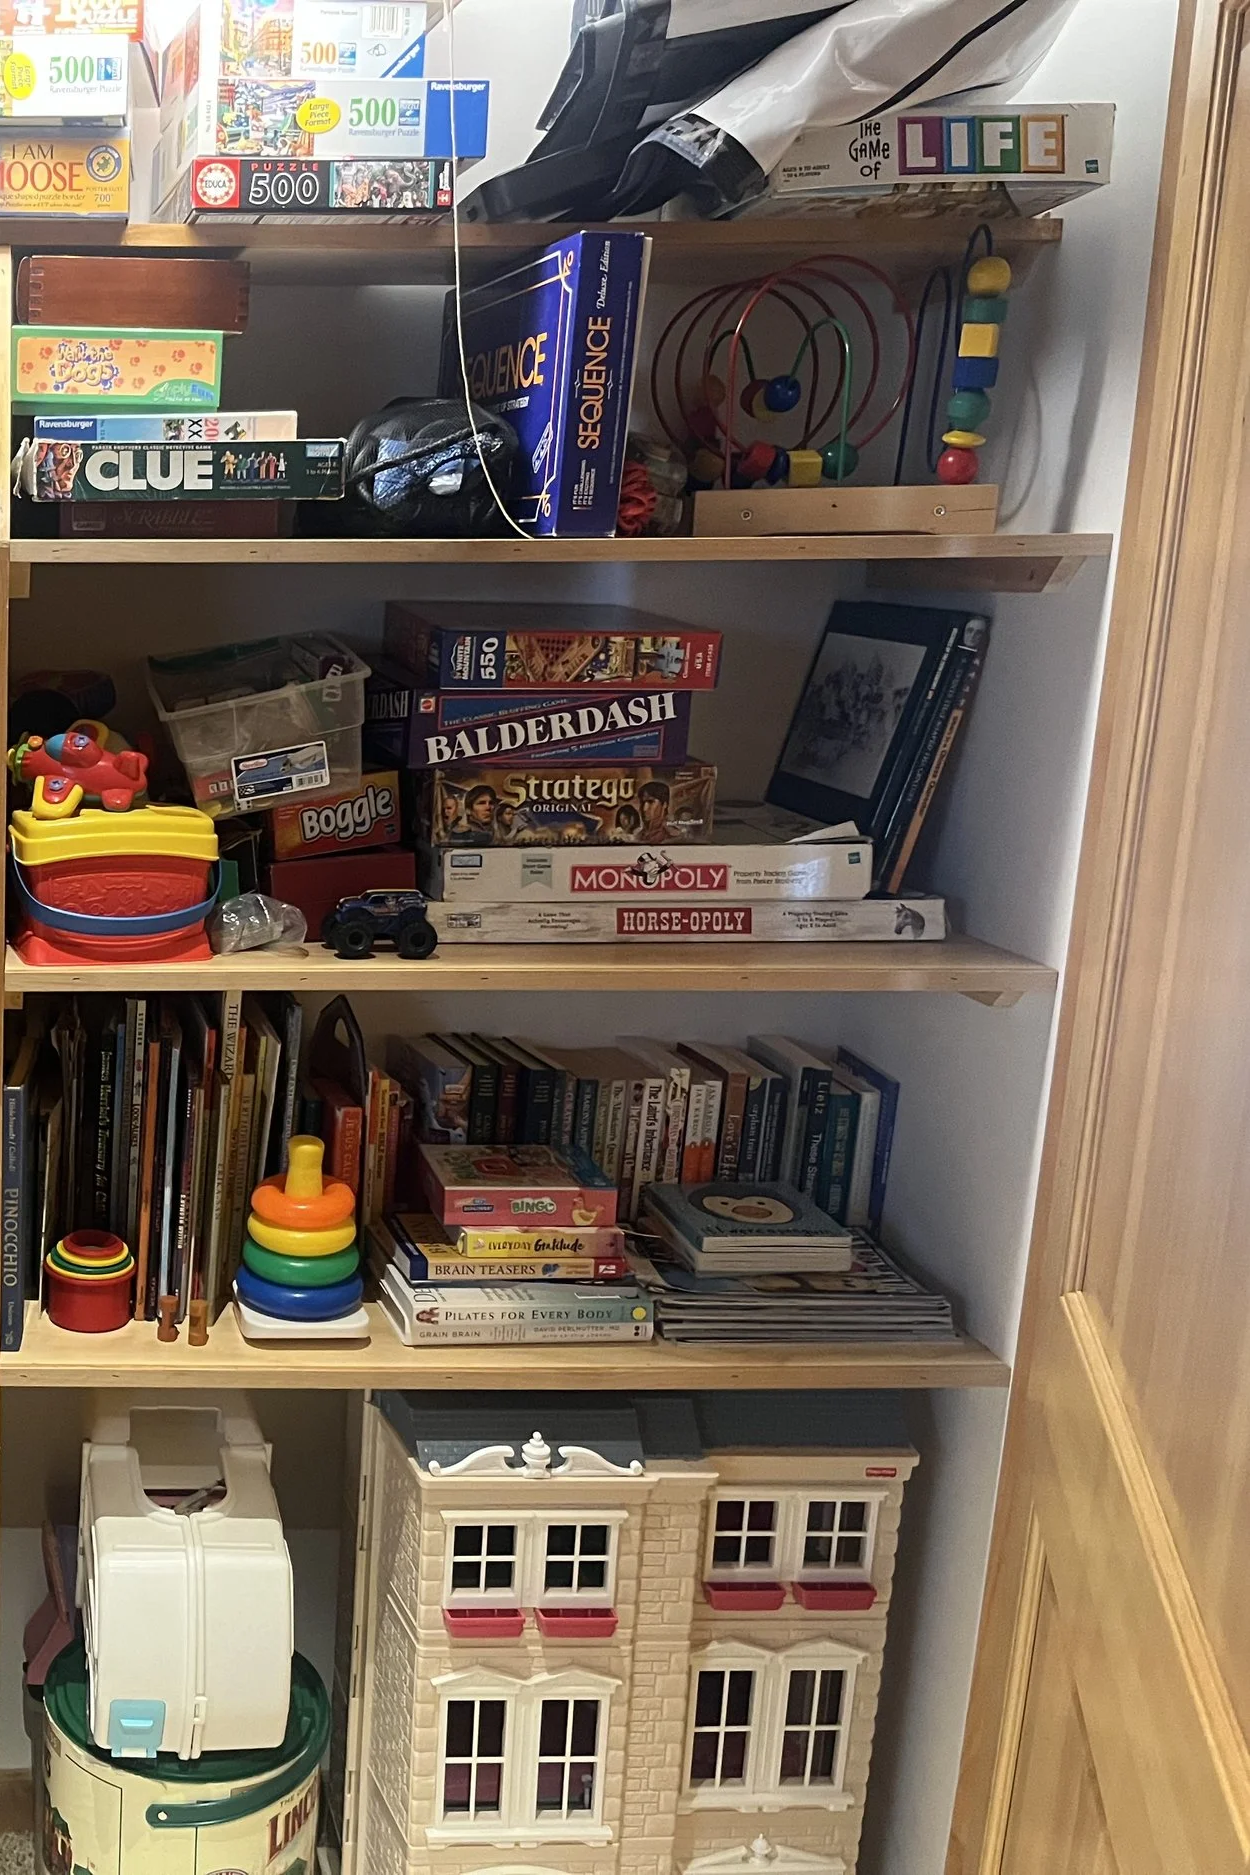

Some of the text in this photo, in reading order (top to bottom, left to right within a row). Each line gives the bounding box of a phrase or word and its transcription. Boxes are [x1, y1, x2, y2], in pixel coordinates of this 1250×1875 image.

[301, 42, 338, 65] 500
[50, 56, 94, 83] 500
[50, 85, 98, 94] Ravensburger
[308, 103, 331, 112] Large
[309, 111, 329, 119] Piece
[349, 99, 397, 127] 500
[305, 118, 332, 126] Format
[348, 128, 420, 138] Ravensburger Puzzle
[12, 144, 54, 159] I AM
[904, 120, 1058, 169] LIFE
[251, 162, 319, 171] PUZZLE
[204, 180, 227, 189] EDUCA
[249, 173, 319, 205] 500
[94, 193, 111, 202] 700
[596, 240, 611, 310] Deluxe Edition
[577, 316, 611, 450] SEQUENCE
[39, 419, 94, 430] Ravensburger
[85, 450, 213, 490] CLUE
[480, 637, 499, 680] 550
[424, 691, 677, 764] BALDERDASH
[505, 772, 635, 807] Stratego
[300, 784, 394, 842] Boggle
[532, 802, 592, 813] ORIGINAL
[622, 911, 745, 933] HORSE-OPOLY
[227, 1004, 238, 1028] THE
[641, 1085, 662, 1172] The Laird's Inheritance
[692, 1108, 702, 1137] KARON
[3, 1188, 19, 1287] PINOCCHIO
[487, 1239, 584, 1252] EVERYDAY Gratitude
[434, 1264, 536, 1276] BRAIN TEASERS
[445, 1309, 613, 1321] PILATES FOR EVERY BODY
[419, 1330, 481, 1339] GRAIN BRAIN
